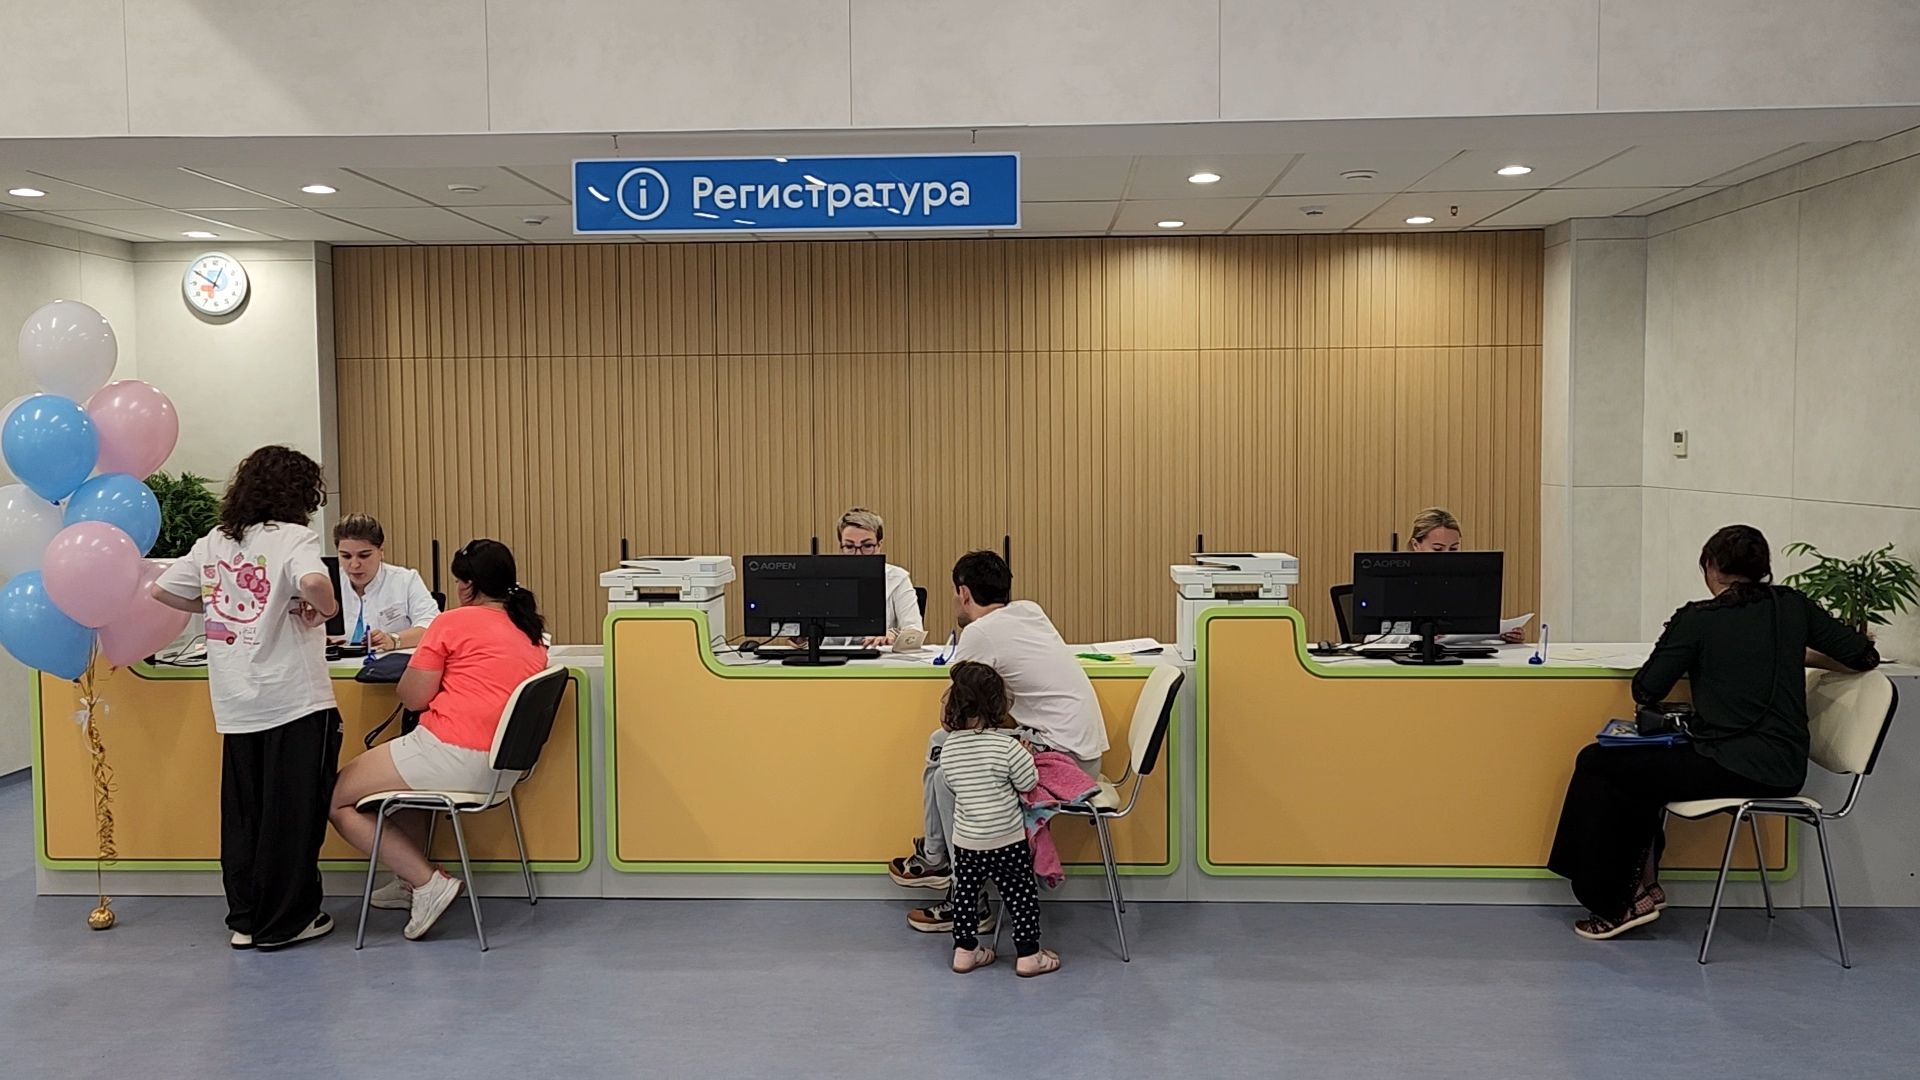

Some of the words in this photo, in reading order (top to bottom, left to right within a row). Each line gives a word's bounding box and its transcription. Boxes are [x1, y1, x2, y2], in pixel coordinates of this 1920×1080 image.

[693, 176, 970, 216] Регистратура
[760, 562, 796, 570] AOPEN
[1373, 560, 1411, 568] AOPEN
